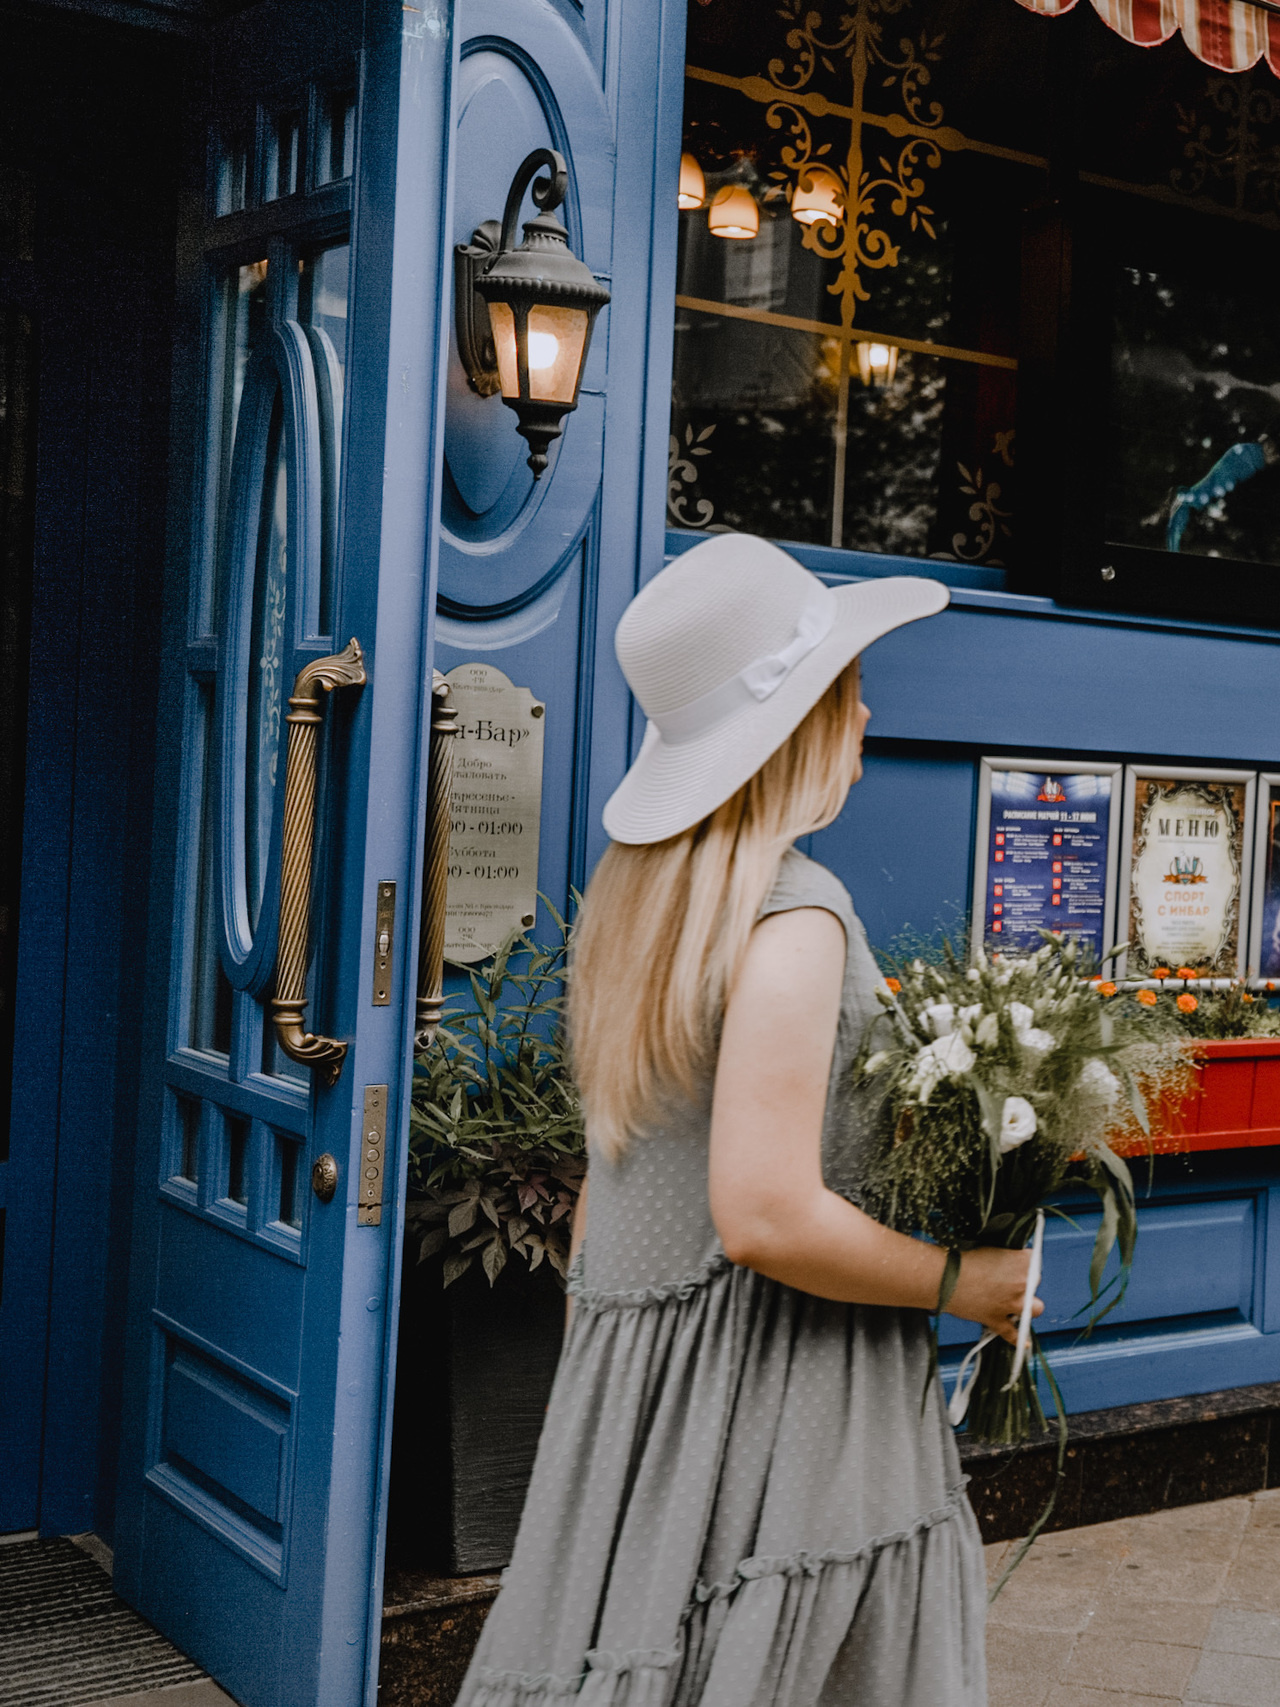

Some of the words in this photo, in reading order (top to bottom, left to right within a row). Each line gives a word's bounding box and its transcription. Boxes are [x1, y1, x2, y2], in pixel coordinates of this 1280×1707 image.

[457, 758, 493, 770] Добро
[477, 821, 523, 835] 01:00
[1158, 818, 1220, 838] МЕНЮ
[474, 865, 519, 879] 01:00
[1164, 890, 1206, 902] СПОРТ
[1157, 905, 1167, 916] С
[1169, 906, 1211, 917] ИНБАР
